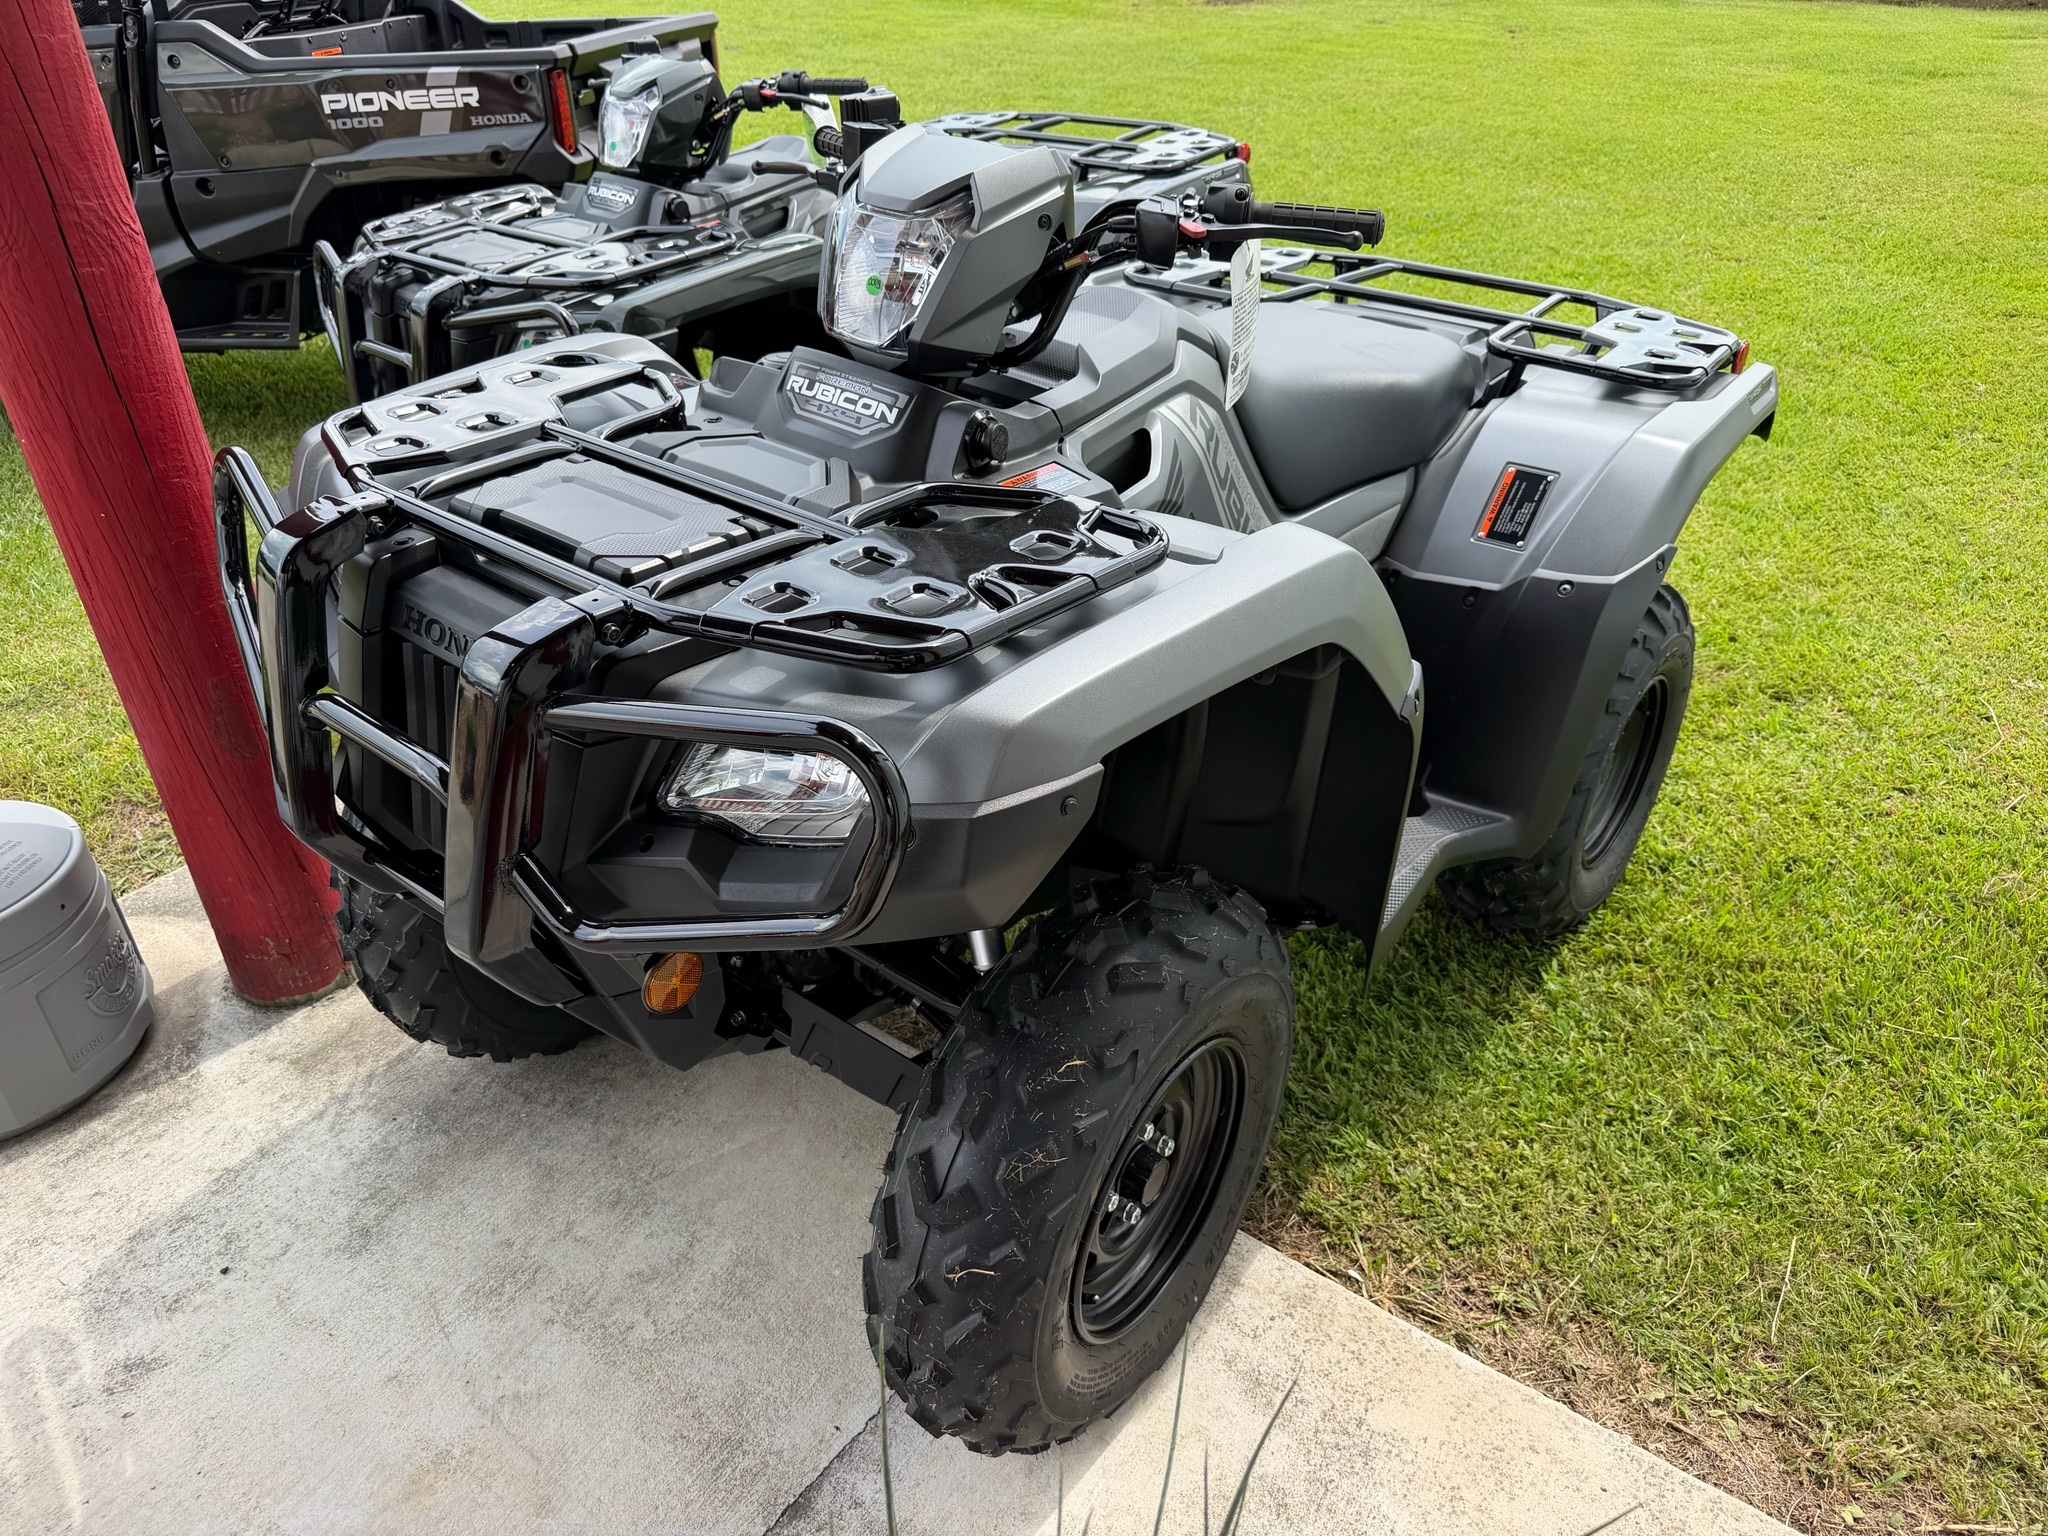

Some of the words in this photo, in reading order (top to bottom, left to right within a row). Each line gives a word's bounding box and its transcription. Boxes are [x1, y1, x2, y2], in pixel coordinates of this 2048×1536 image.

[320, 86, 481, 114] PIONEER
[327, 116, 384, 130] 1000
[469, 113, 533, 126] HONDA
[587, 186, 635, 205] RUBICON
[815, 372, 872, 396] FOREMAN
[820, 367, 841, 376] POWER
[841, 373, 871, 386] STEERING
[786, 374, 899, 424] RUBICON
[1489, 482, 1508, 514] WARNING
[401, 603, 476, 660] HON
[72, 1033, 104, 1063] ULINE
